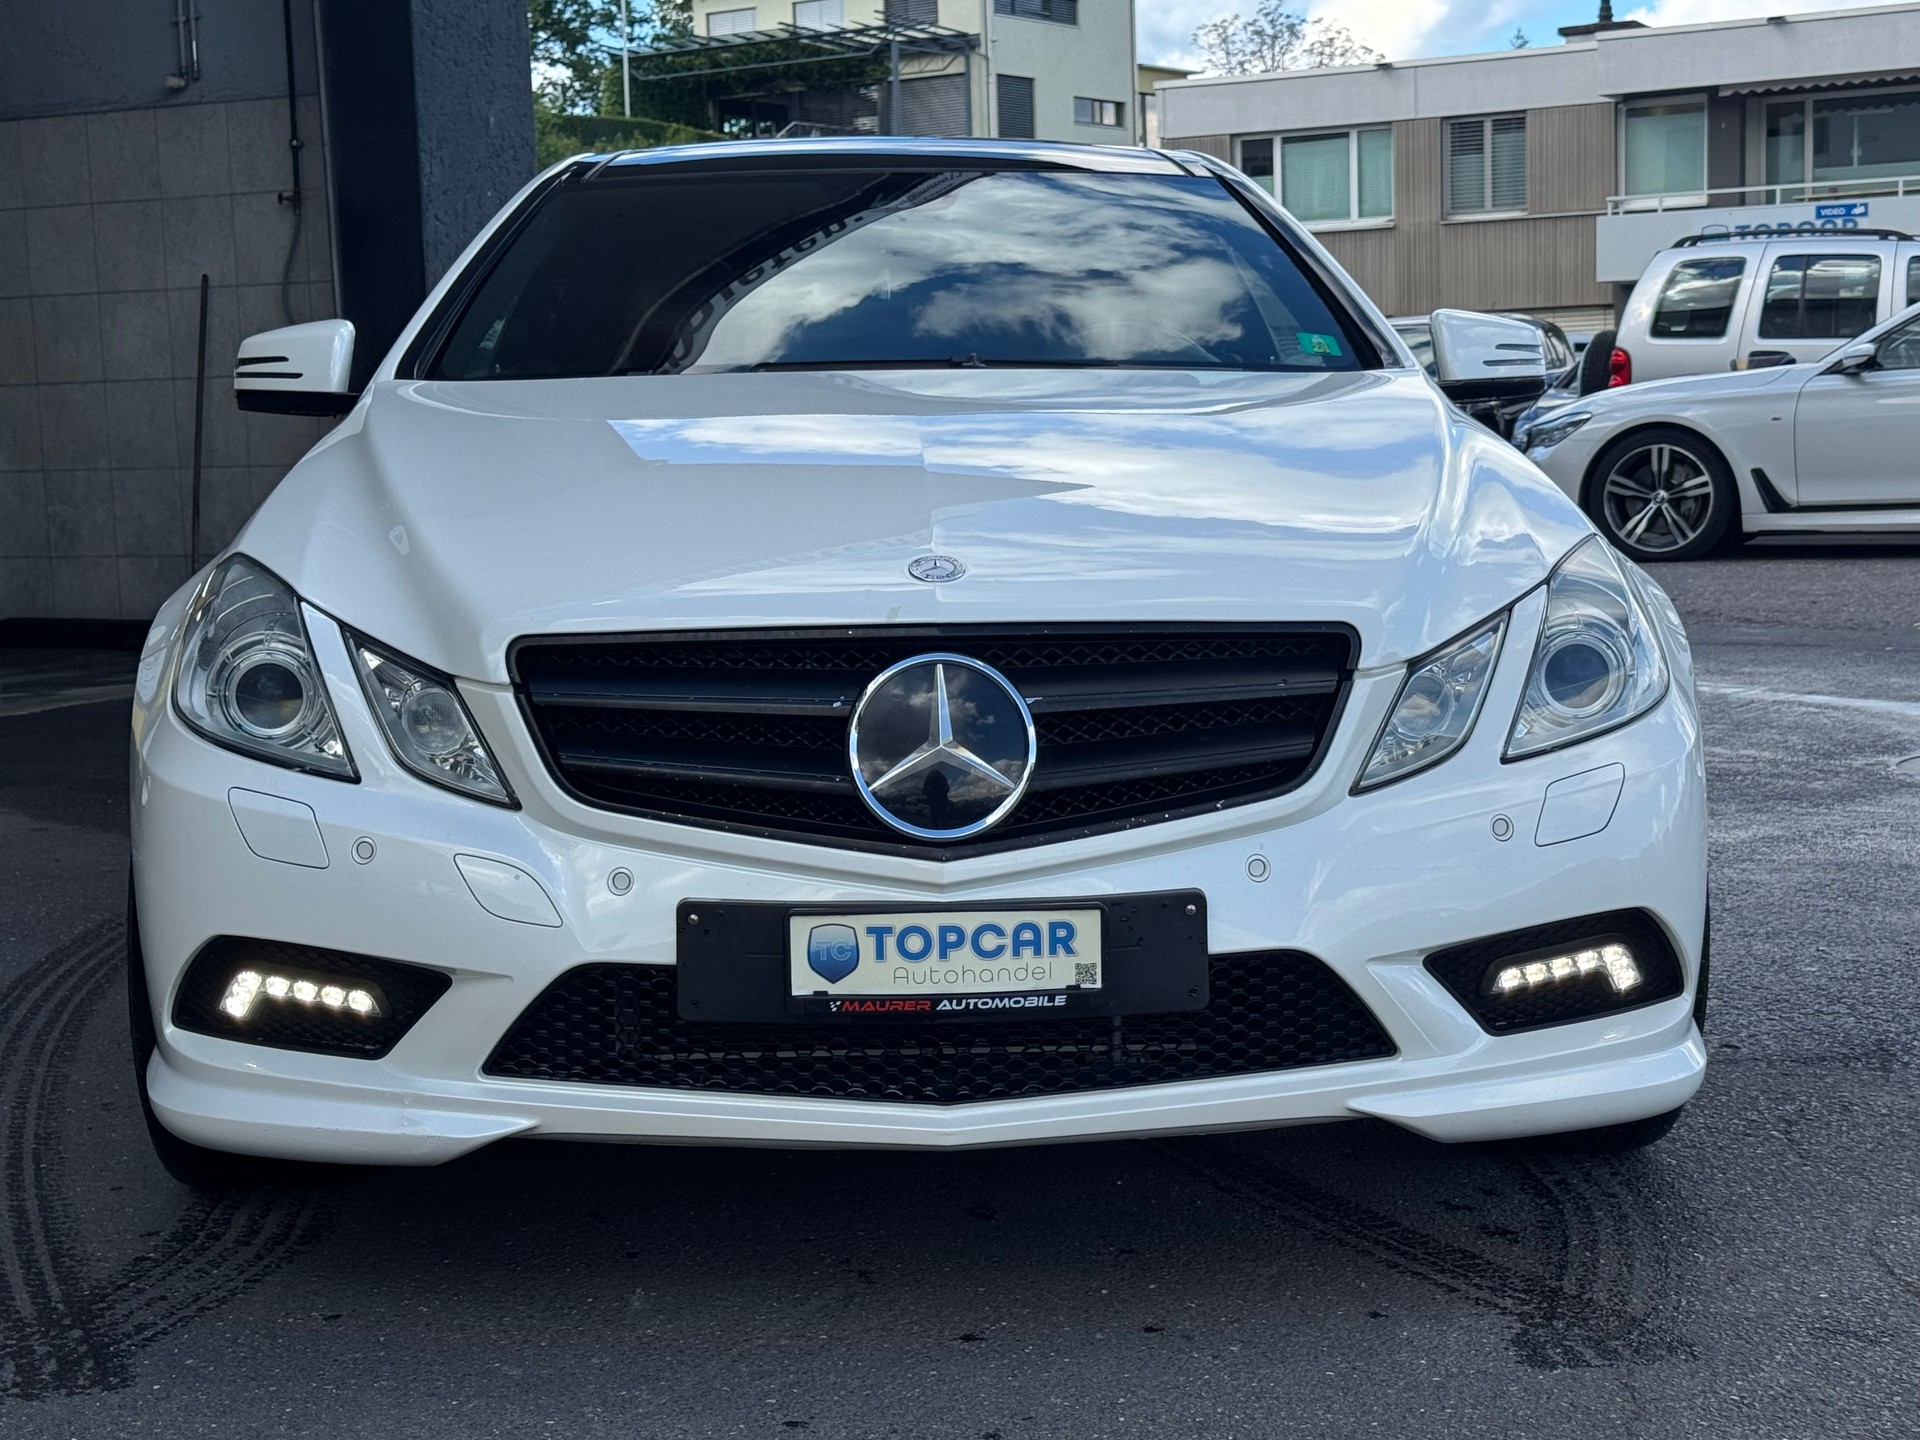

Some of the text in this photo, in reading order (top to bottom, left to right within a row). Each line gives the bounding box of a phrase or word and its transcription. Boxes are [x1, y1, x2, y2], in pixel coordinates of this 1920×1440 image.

[1820, 207, 1846, 217] VIDEO
[816, 940, 852, 962] TC
[865, 919, 1079, 962] TOPCAR
[892, 962, 1053, 985] Autohandel
[841, 995, 1068, 1012] MAURER AUTOMOBILE
